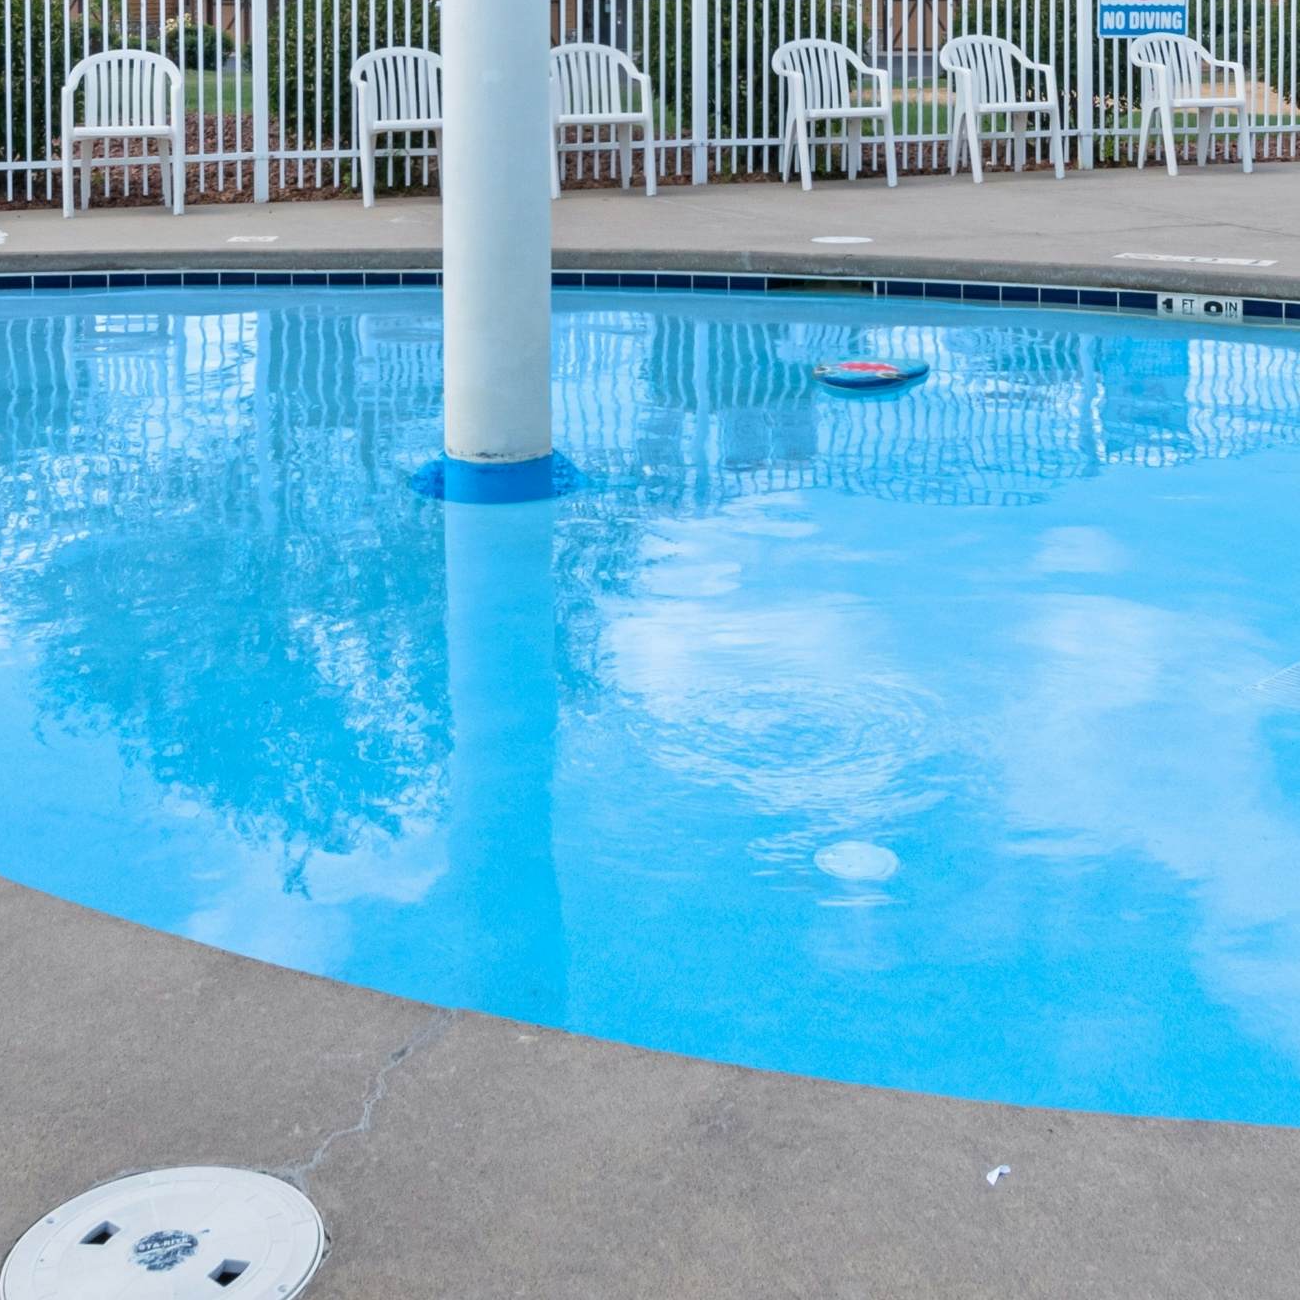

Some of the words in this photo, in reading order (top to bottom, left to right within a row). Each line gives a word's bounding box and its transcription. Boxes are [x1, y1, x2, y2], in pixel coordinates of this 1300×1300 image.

[1103, 11, 1125, 30] NO
[1129, 11, 1182, 30] DIVING
[1162, 298, 1173, 313] 1
[1182, 299, 1194, 309] FT
[1225, 302, 1238, 312] IN
